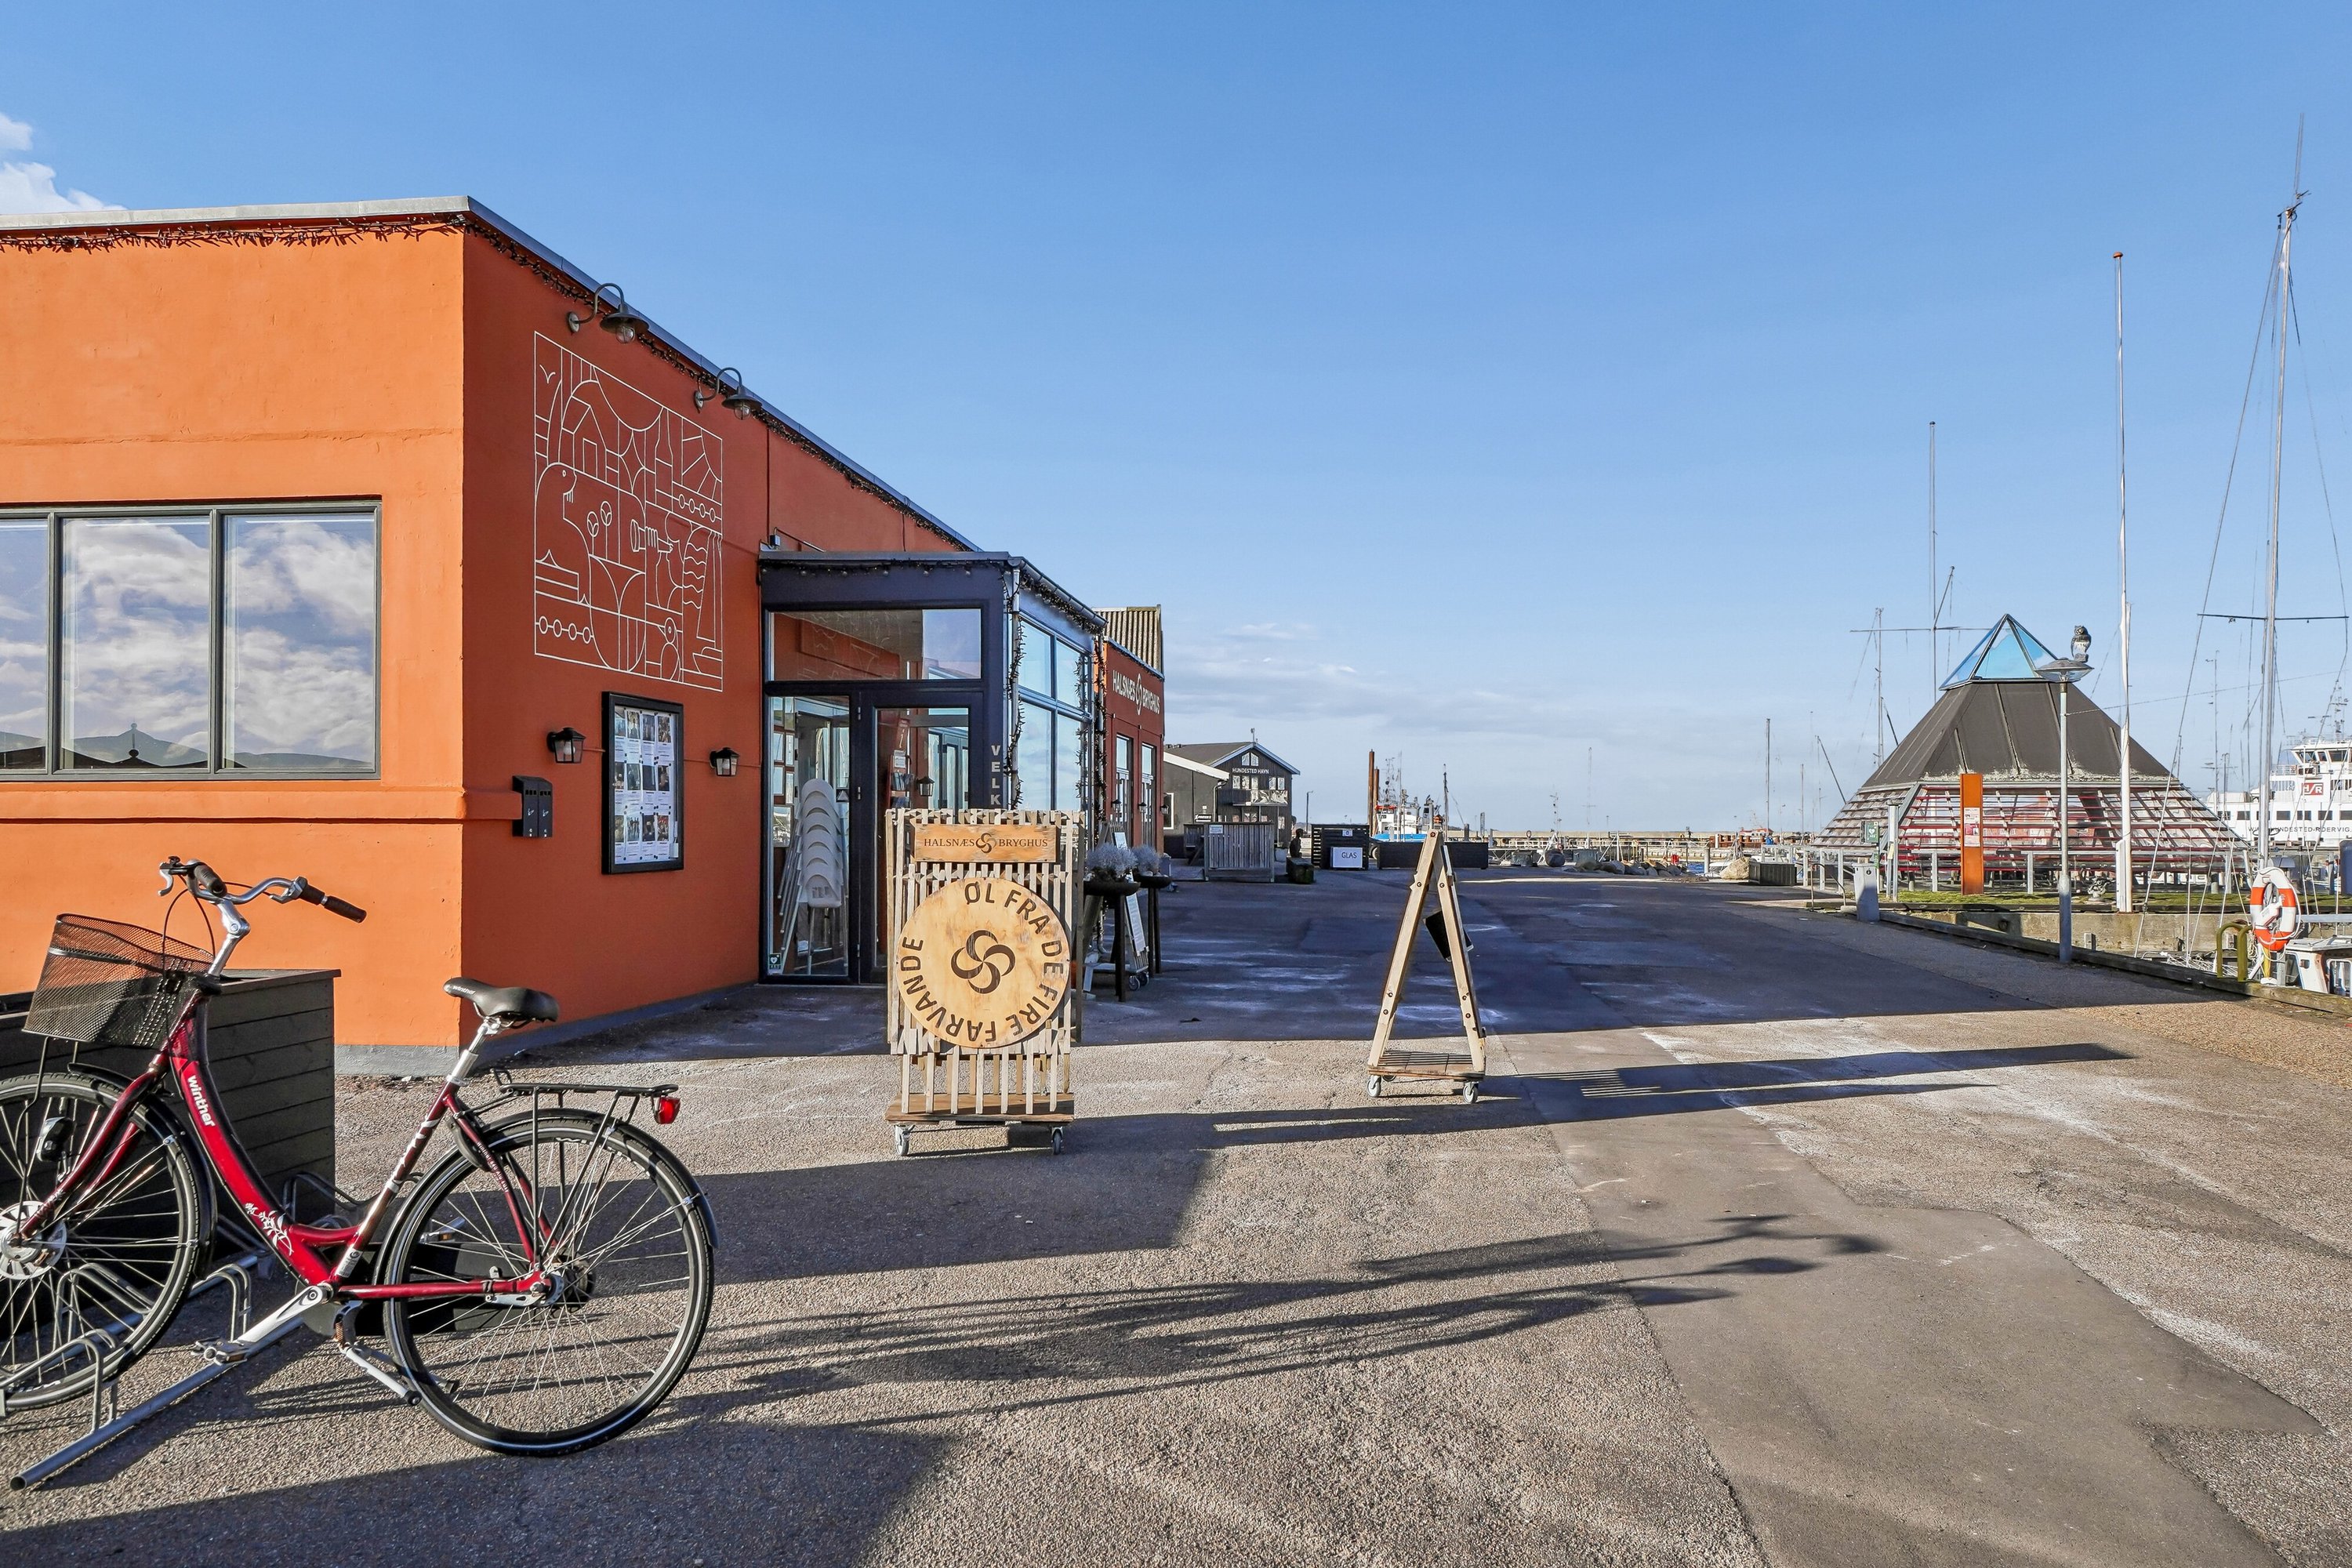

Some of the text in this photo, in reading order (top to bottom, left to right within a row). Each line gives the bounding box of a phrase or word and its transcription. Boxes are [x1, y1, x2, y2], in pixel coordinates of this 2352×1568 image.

[1112, 670, 1136, 702] HALSNÆS
[924, 838, 1048, 847] HALSNÆS BRYGHUS
[900, 880, 1064, 1043] ØL FRA DE FIRE FARVANDE
[187, 1074, 216, 1127] winther
